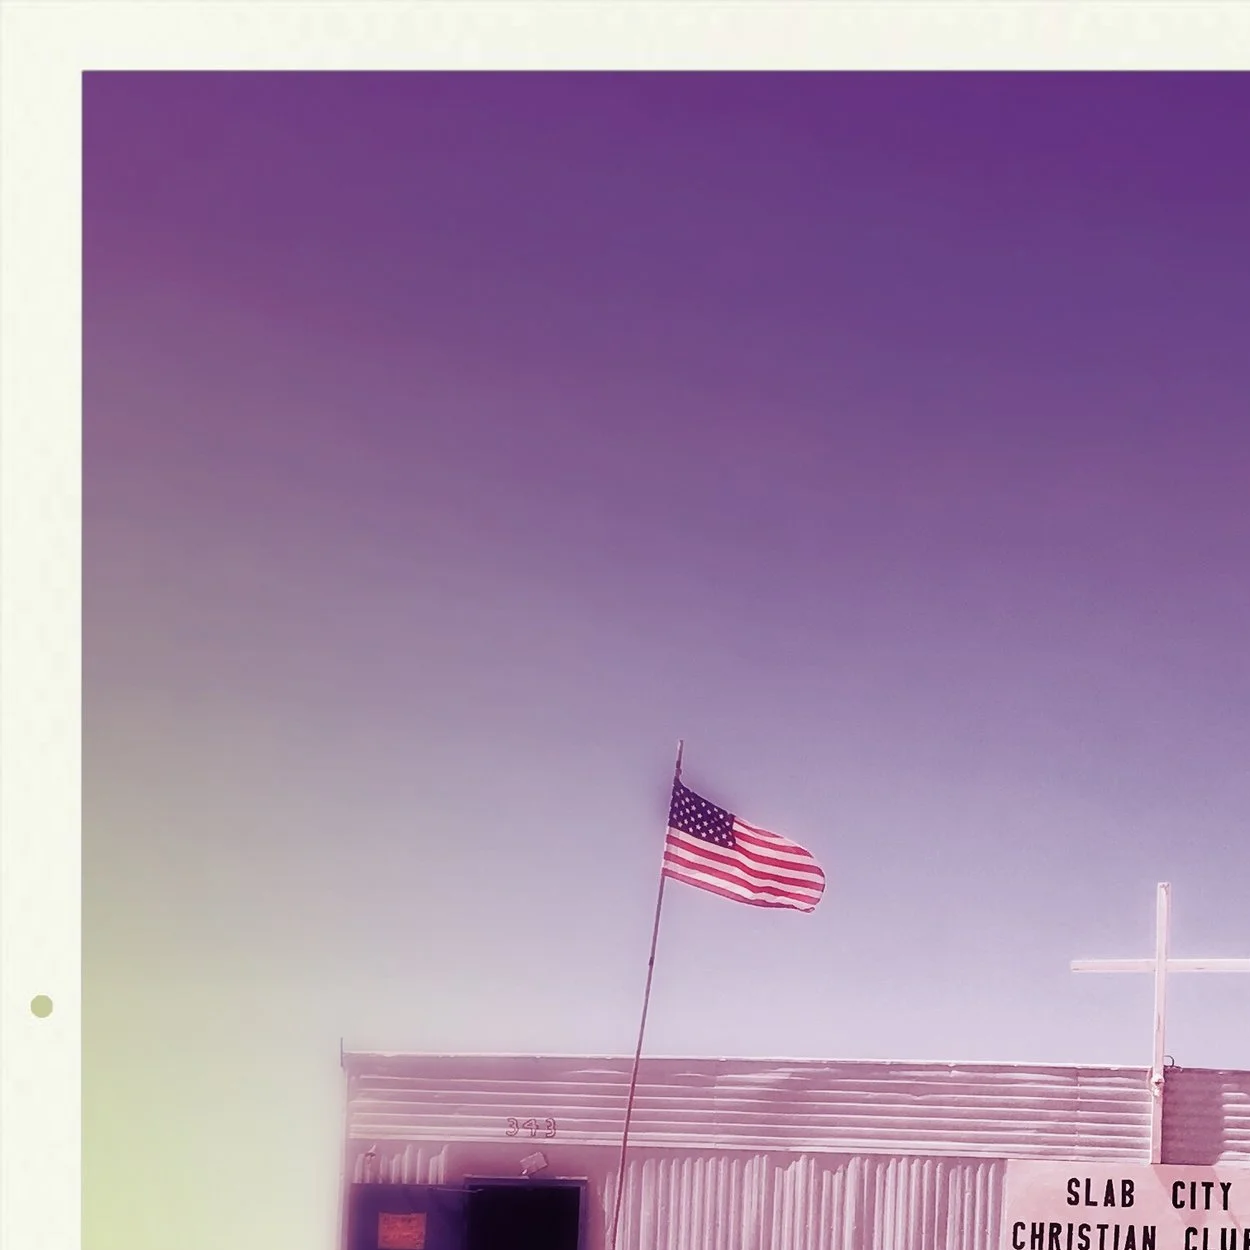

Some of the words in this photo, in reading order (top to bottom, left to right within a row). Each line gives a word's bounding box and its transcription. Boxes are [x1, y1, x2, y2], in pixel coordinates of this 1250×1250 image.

[505, 1117, 556, 1138] 343
[1067, 1177, 1135, 1207] SLAB
[1171, 1181, 1232, 1210] CITY
